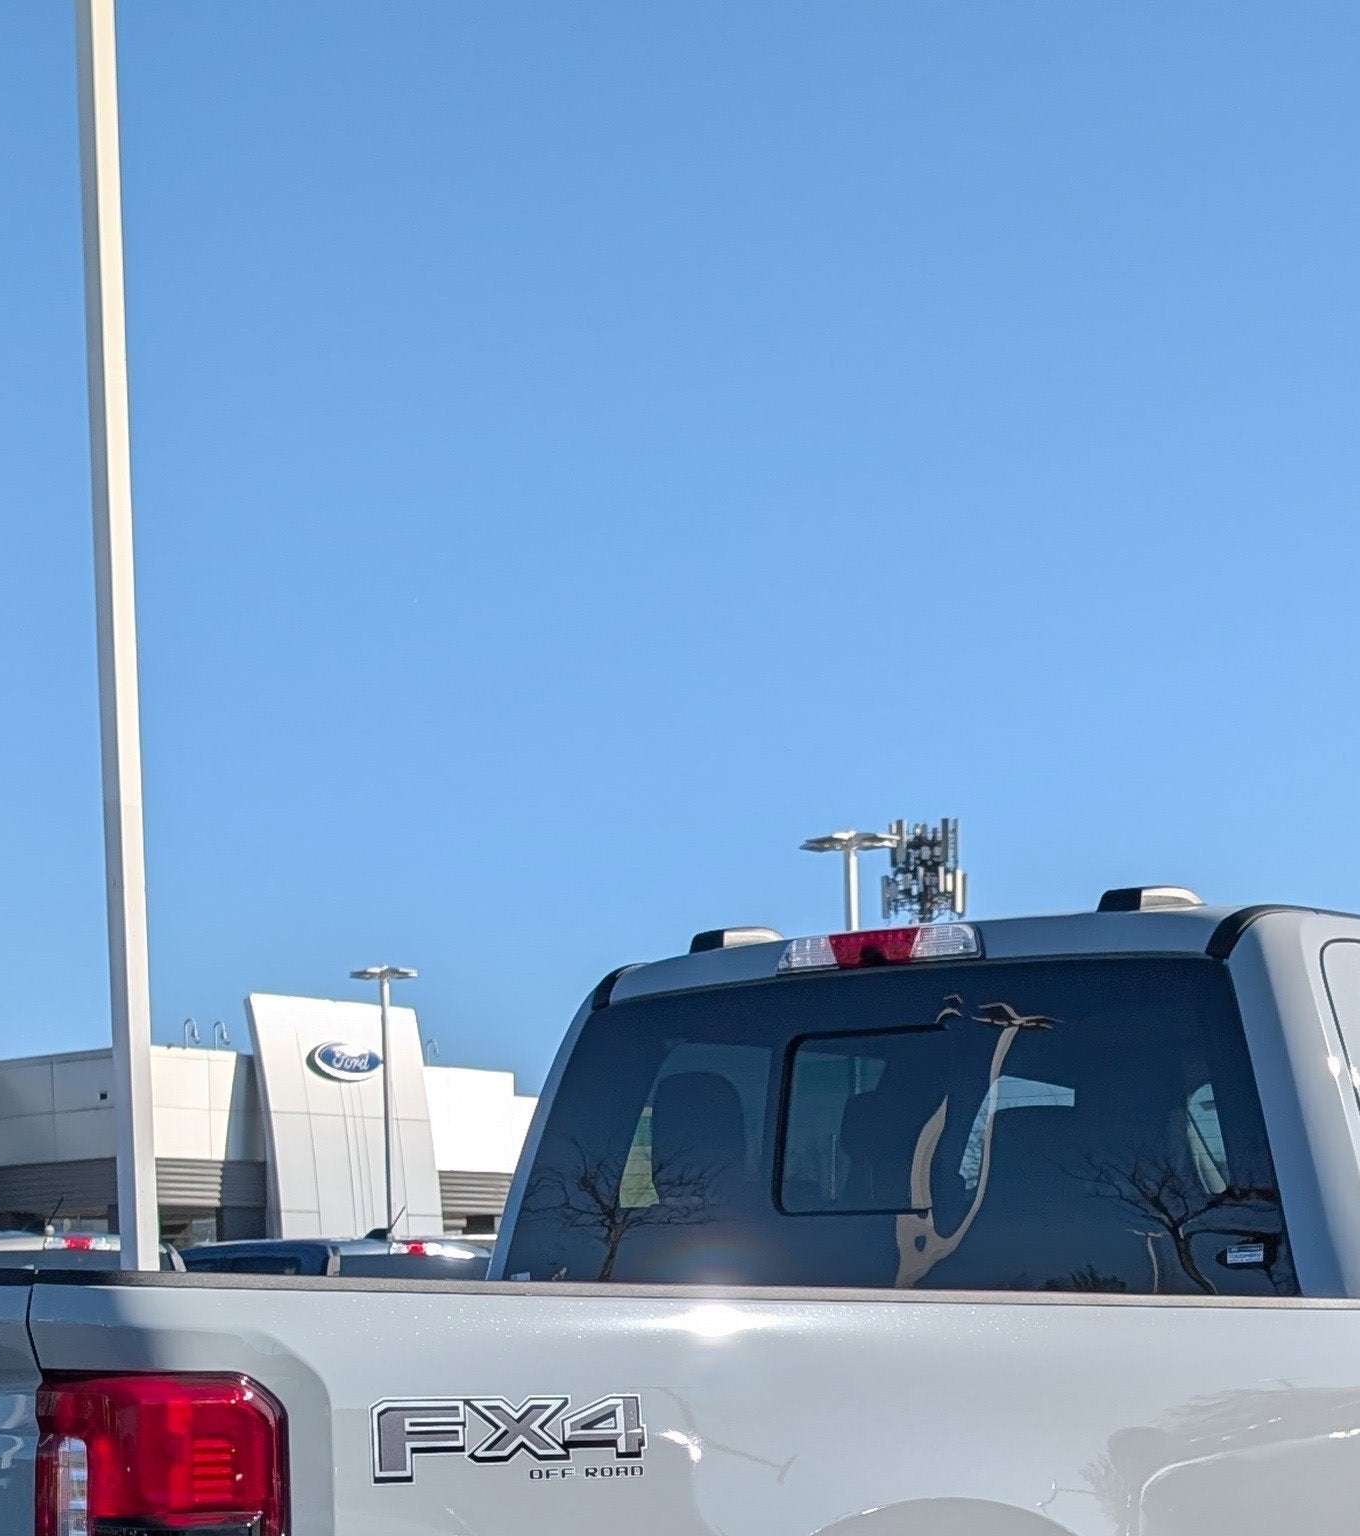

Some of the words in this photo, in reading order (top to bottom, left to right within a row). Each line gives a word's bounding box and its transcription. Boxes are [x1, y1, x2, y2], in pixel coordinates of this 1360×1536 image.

[370, 1394, 647, 1485] FX4
[529, 1467, 575, 1480] OFF
[585, 1465, 644, 1479] ROAD
